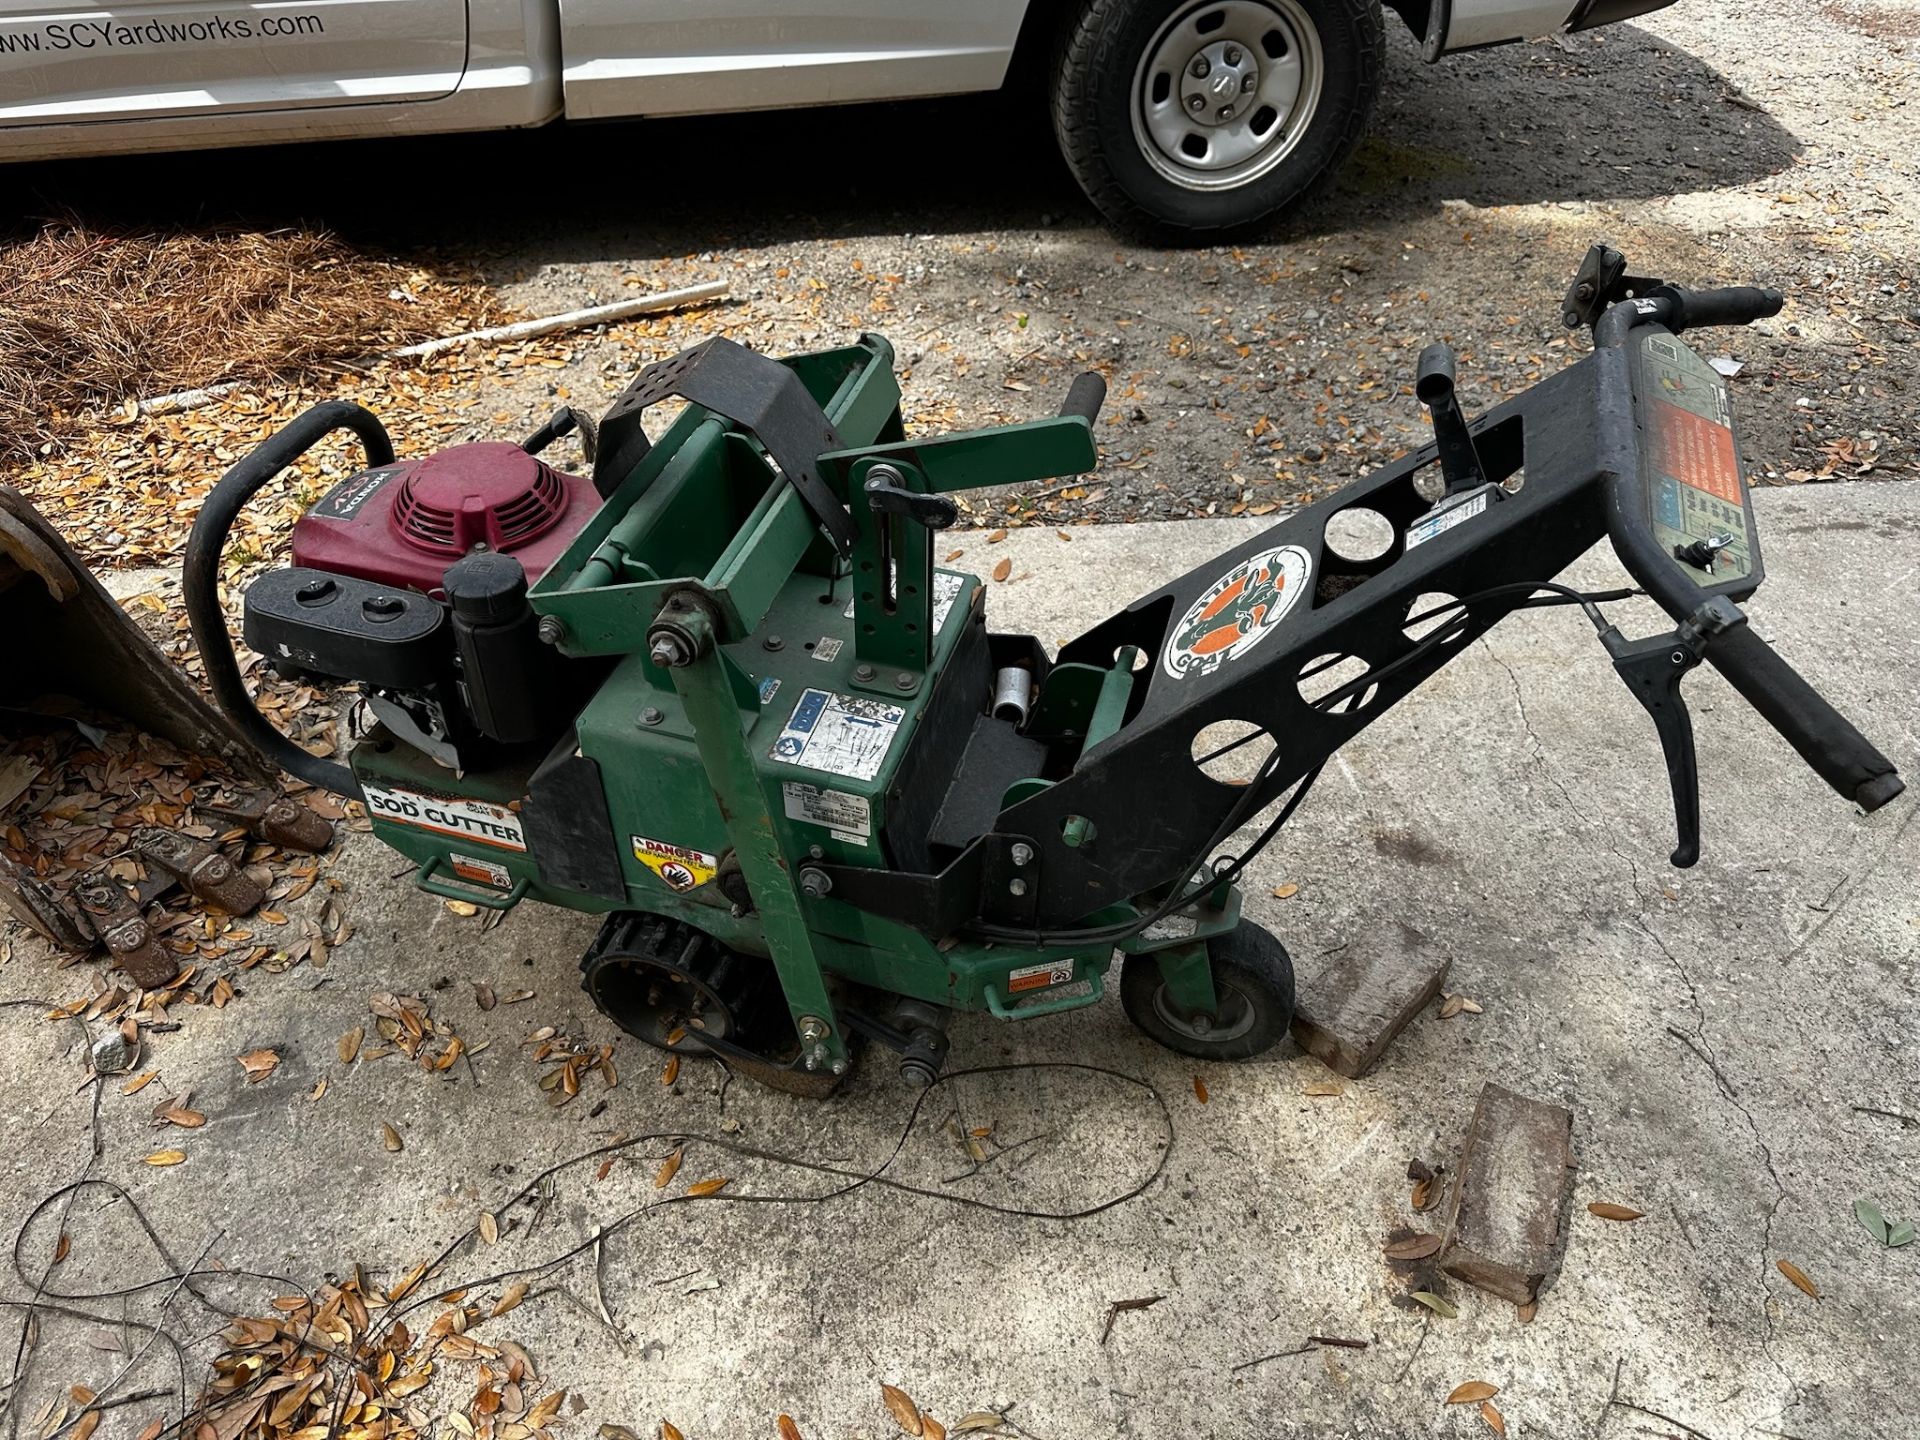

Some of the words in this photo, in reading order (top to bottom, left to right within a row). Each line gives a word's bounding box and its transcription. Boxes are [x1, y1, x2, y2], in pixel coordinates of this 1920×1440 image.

[339, 472, 390, 514] HONDA
[1186, 566, 1249, 626] BILLY
[1176, 643, 1238, 670] GOAT
[371, 795, 420, 818] SOD
[425, 808, 523, 843] CUTTER
[645, 840, 704, 863] DANGER
[1011, 977, 1050, 989] WARNING
